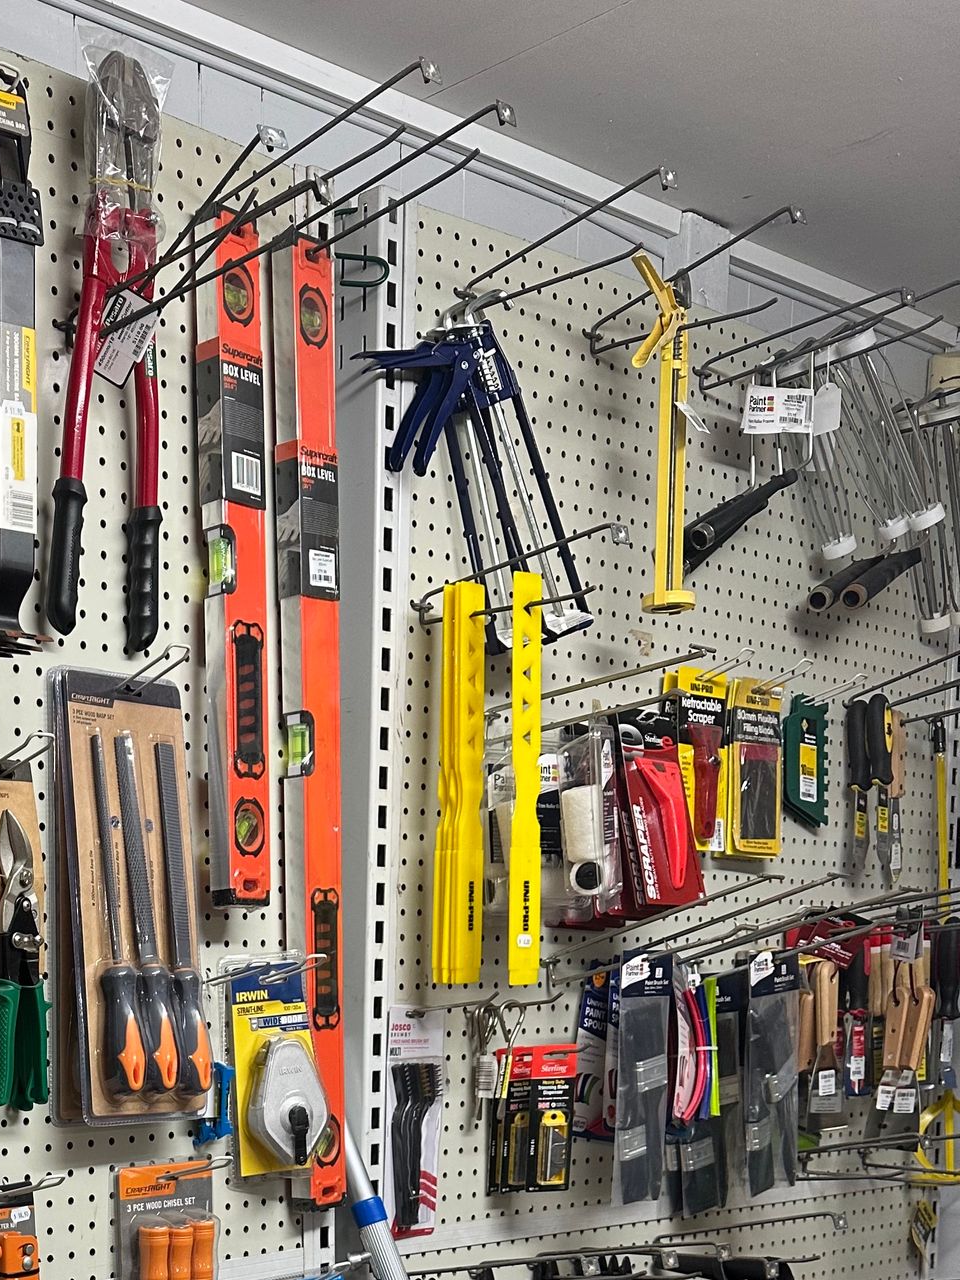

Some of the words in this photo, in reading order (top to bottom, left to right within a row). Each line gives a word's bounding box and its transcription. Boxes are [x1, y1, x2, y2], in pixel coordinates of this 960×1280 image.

[221, 343, 263, 367] Supercraft
[222, 362, 240, 379] BOX
[240, 367, 261, 386] LEVEL
[749, 395, 767, 406] Paint
[748, 405, 767, 413] Partner
[300, 445, 338, 464] Supercraft
[301, 464, 316, 479] BOX
[316, 469, 336, 483] LEVEL
[690, 683, 714, 694] UNI-PRO
[681, 696, 722, 713] Retractable
[687, 711, 716, 725] Scraper
[632, 803, 658, 900] SCRAPER
[467, 880, 475, 932] UNI-PRO
[522, 880, 531, 932] UNI-PRO
[625, 962, 640, 973] Paint
[235, 989, 269, 1003] IRWIN
[585, 1007, 606, 1022] PAINT
[391, 1023, 411, 1032] JOSCO
[540, 1063, 569, 1074] Sterling
[125, 1182, 173, 1196] CRAFTRIGHT
[145, 1200, 162, 1211] WOOD
[163, 1198, 183, 1209] CHISEL
[183, 1196, 196, 1206] SET
